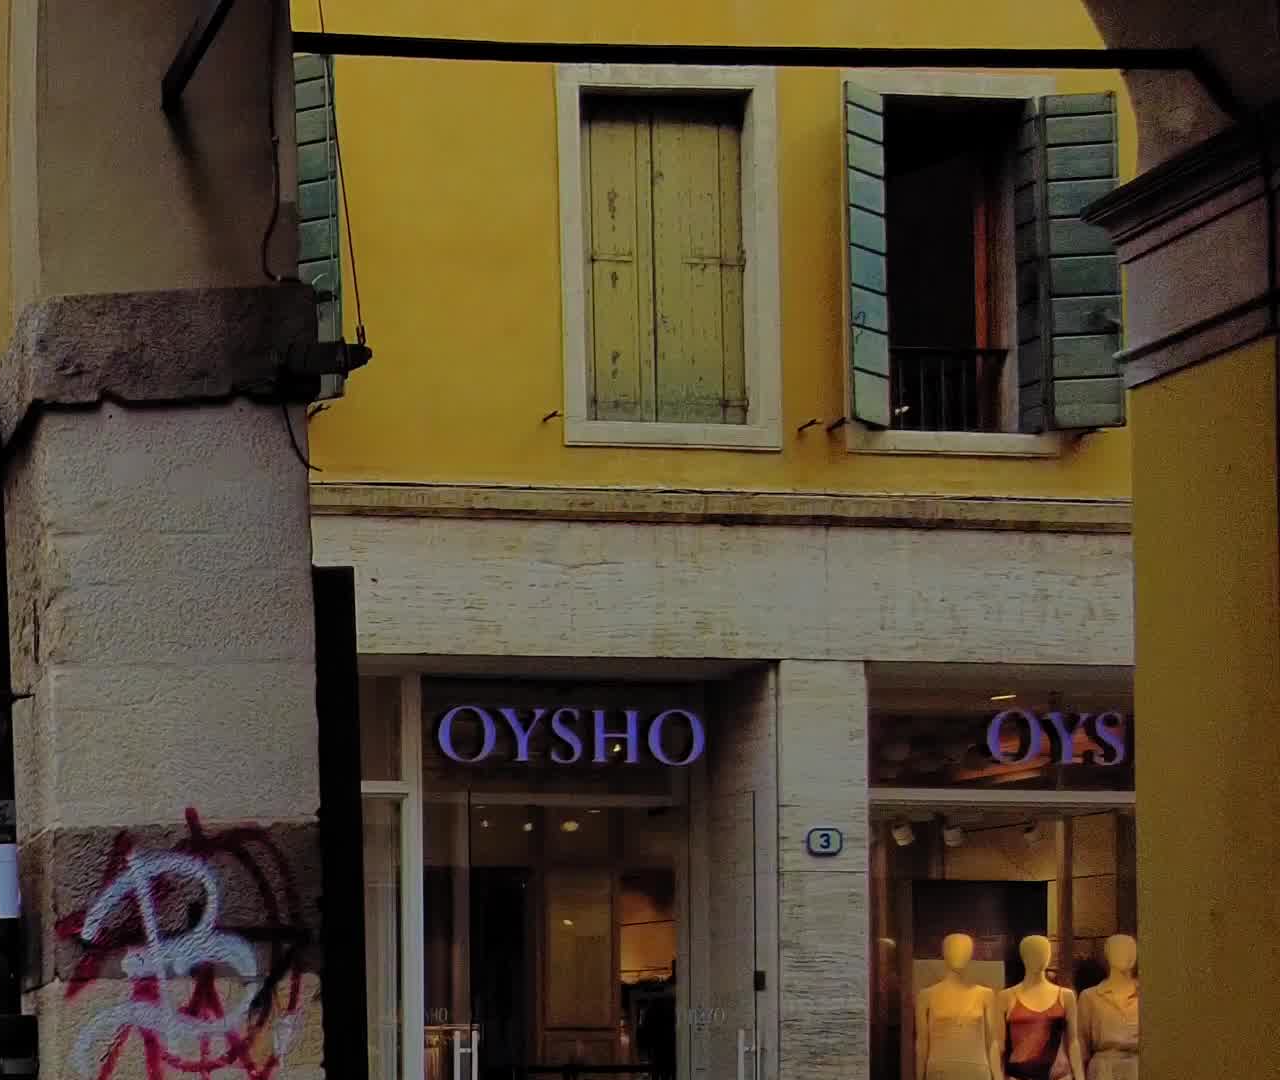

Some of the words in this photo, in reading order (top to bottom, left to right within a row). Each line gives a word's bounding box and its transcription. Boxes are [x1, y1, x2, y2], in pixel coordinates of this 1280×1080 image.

[437, 703, 707, 767] OYSHO
[986, 706, 1126, 767] OYS
[819, 833, 831, 849] 3
